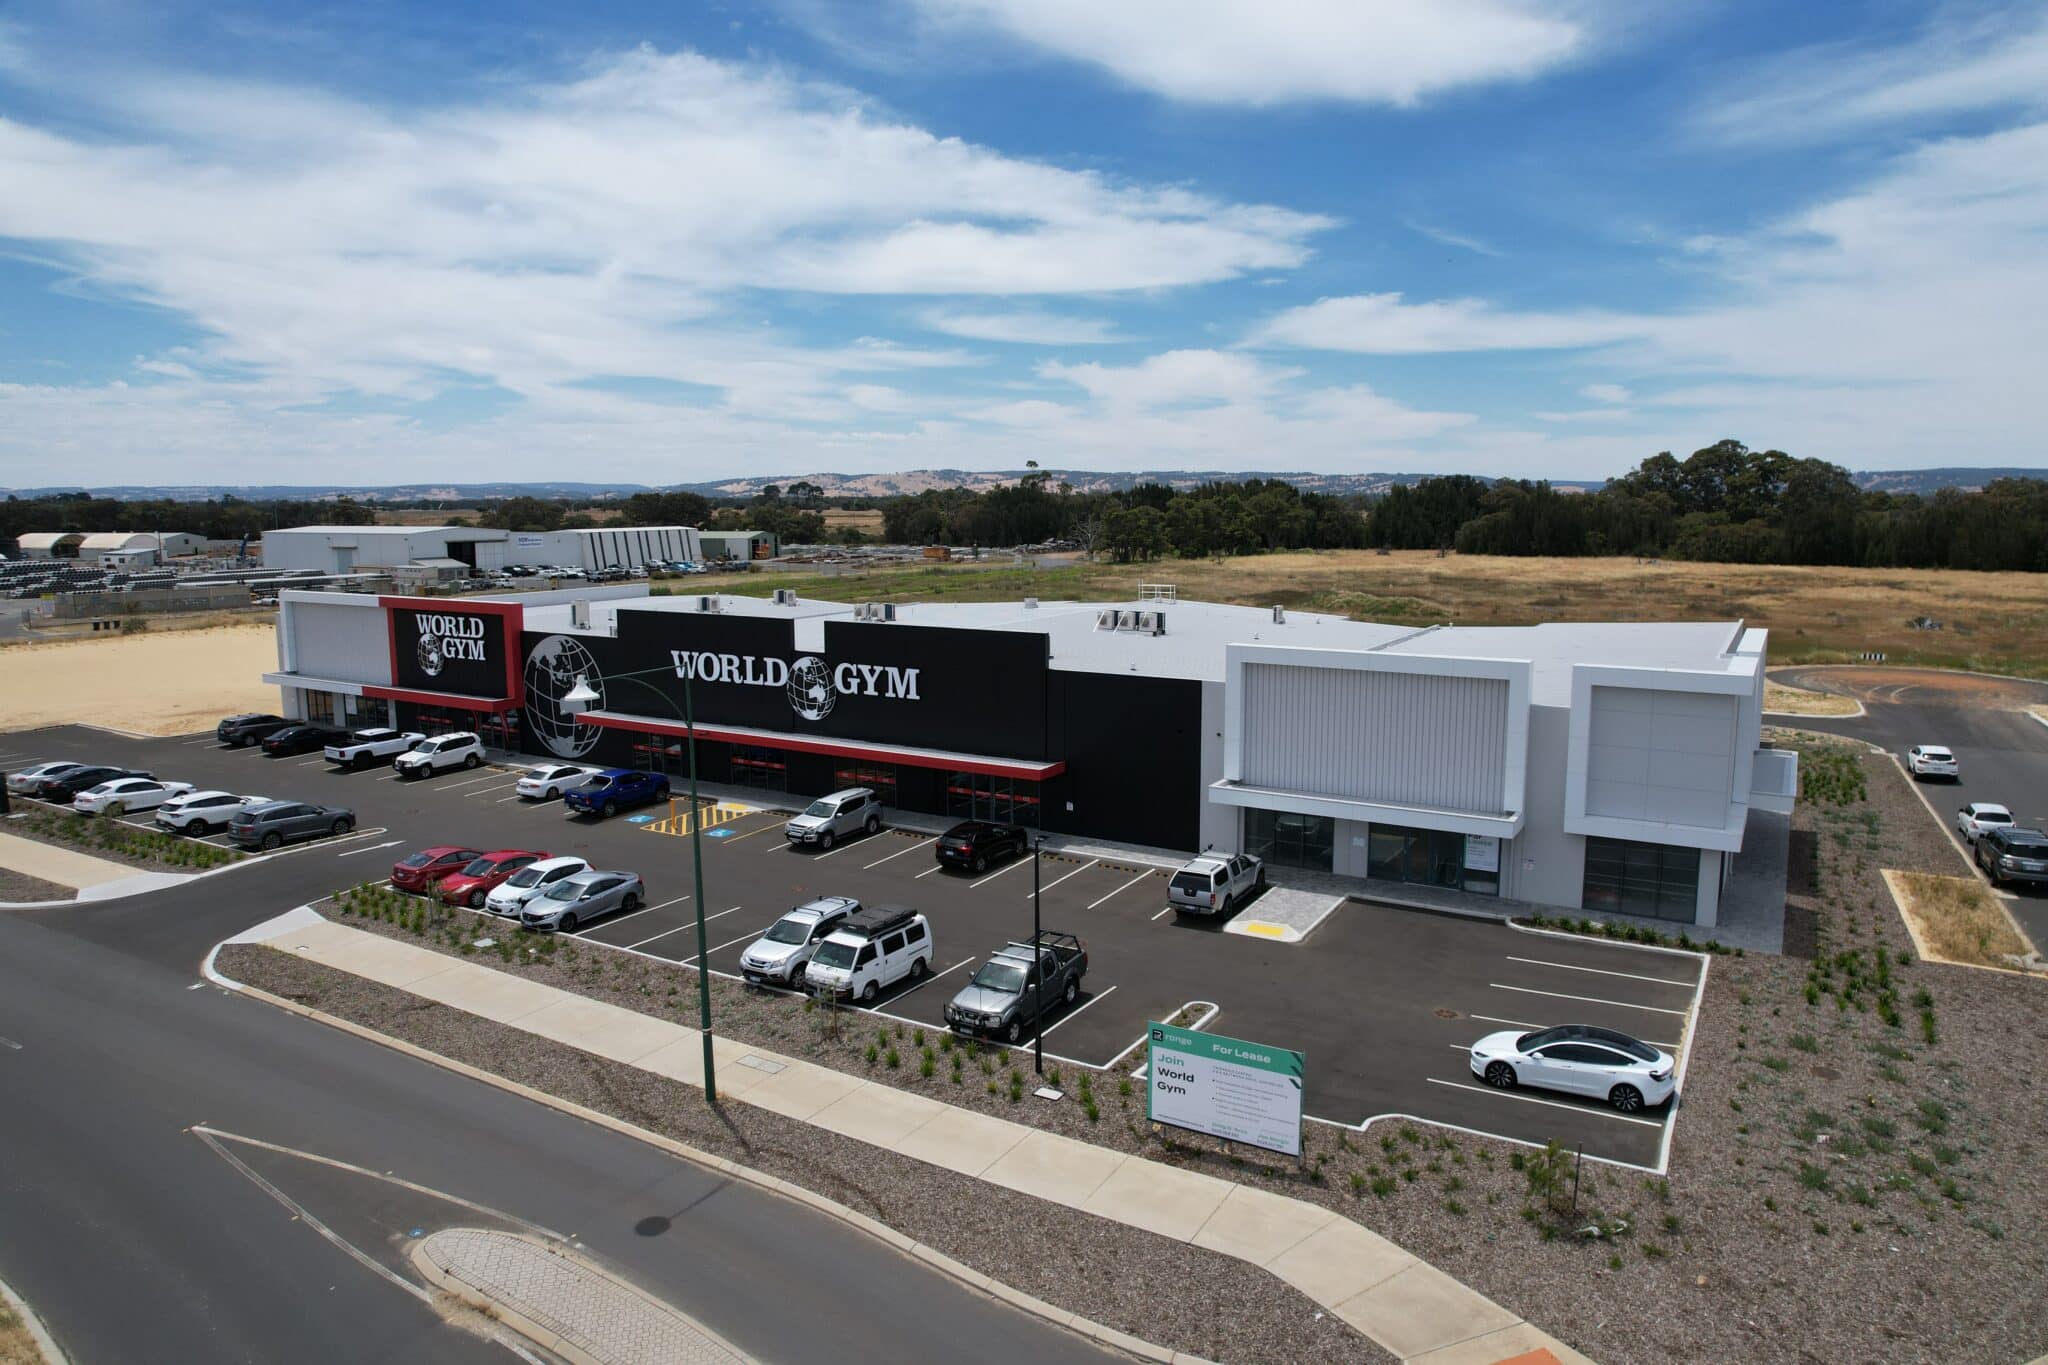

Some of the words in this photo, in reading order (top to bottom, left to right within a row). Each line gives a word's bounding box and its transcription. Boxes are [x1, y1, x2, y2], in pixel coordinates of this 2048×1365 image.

[415, 613, 485, 639] WORLD
[442, 637, 487, 661] GYM
[670, 650, 788, 687] WORLD
[834, 662, 921, 700] GYM
[1158, 1054, 1185, 1067] Join
[1212, 1044, 1232, 1055] For
[1234, 1048, 1271, 1064] Lease
[1157, 1066, 1195, 1083] World
[1157, 1081, 1186, 1096] Gym
